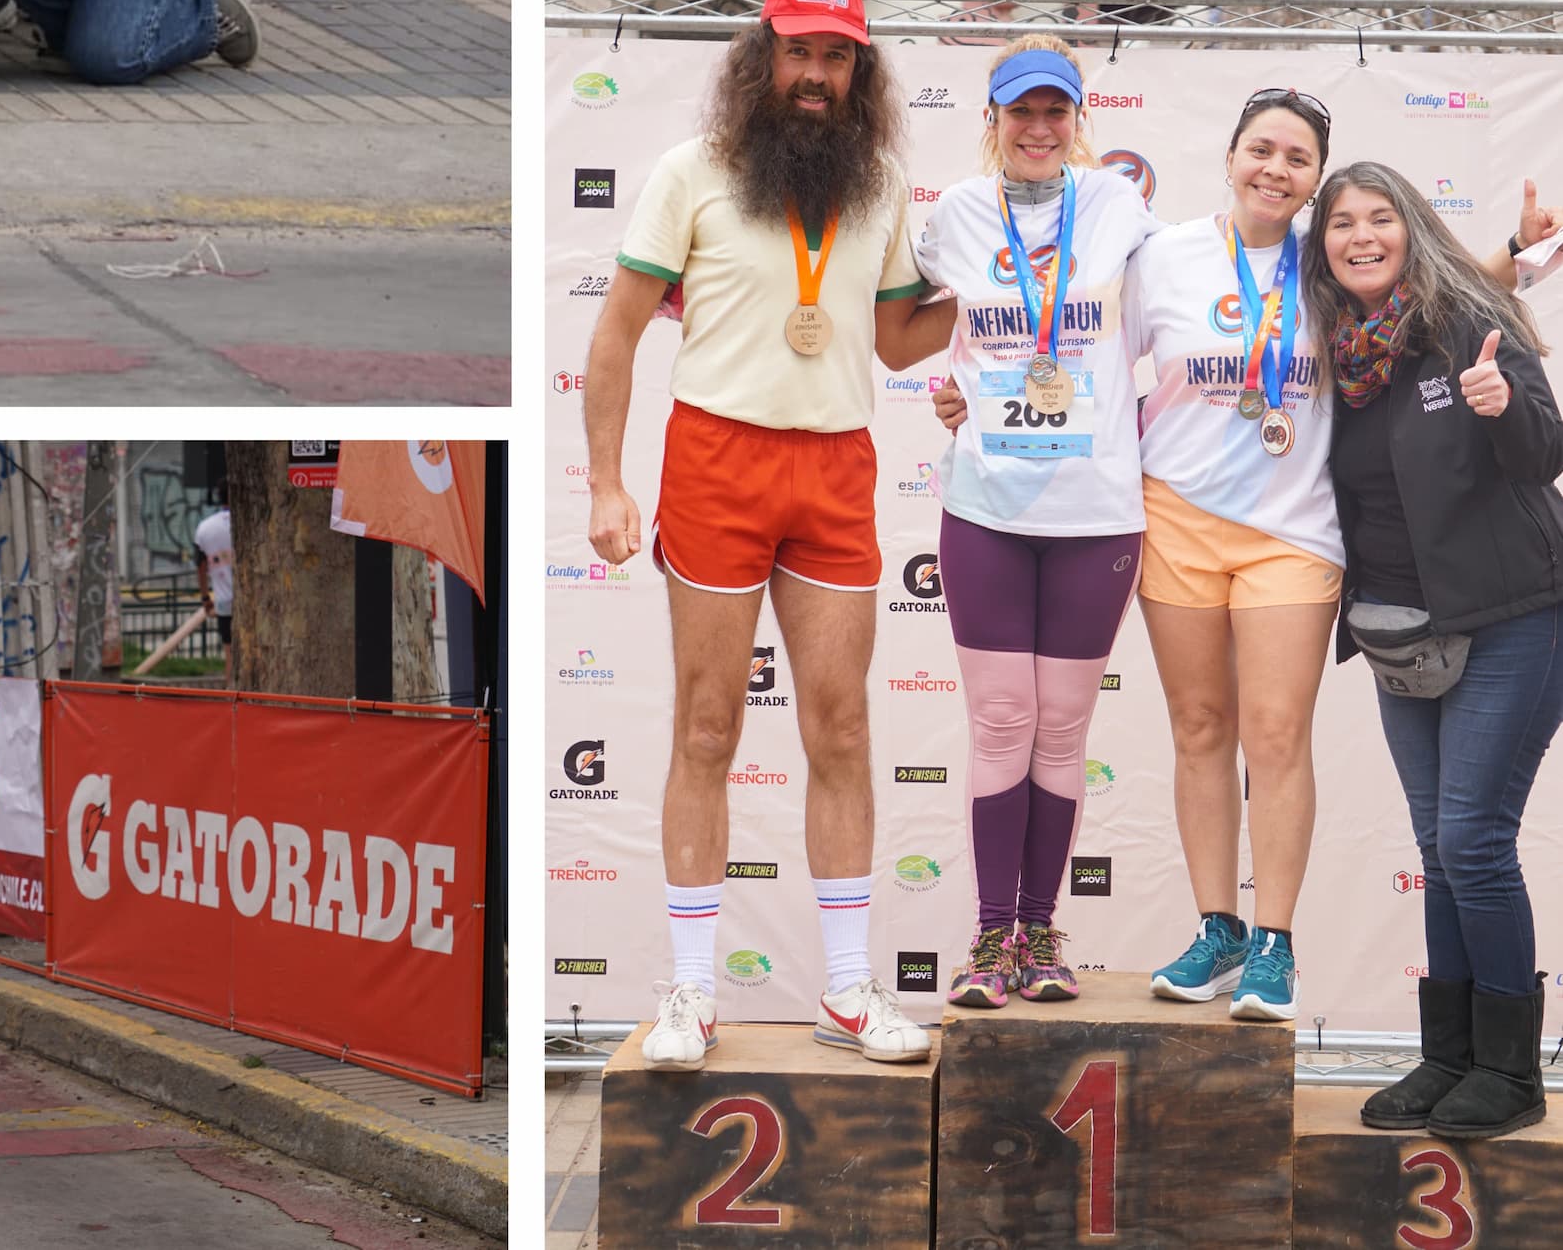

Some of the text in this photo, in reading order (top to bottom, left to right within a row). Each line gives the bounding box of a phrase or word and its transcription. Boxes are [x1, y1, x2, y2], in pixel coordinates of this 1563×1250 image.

[909, 101, 956, 110] RUNNERSZIK
[1088, 92, 1143, 108] Basani
[1405, 92, 1446, 109] Contigo
[578, 180, 610, 188] COLOR
[580, 188, 610, 196] MOVE
[982, 339, 1018, 350] CORRIDA
[886, 376, 927, 394] Contigo
[1200, 388, 1238, 400] CORRIDA
[1423, 397, 1454, 414] Nestlé
[547, 564, 587, 581] Contigo
[558, 667, 615, 680] espress
[888, 679, 957, 692] TRENCITO
[563, 739, 605, 786] G
[907, 769, 946, 782] FINISHER
[549, 789, 619, 800] GATORADE
[67, 773, 456, 955] G GATORADE
[548, 869, 617, 882] TRENCITO
[738, 864, 777, 878] FINISHER
[1075, 868, 1106, 876] COLOR
[1078, 876, 1106, 884] MOVE
[567, 960, 606, 974] FINISHER
[901, 963, 932, 972] COLOR
[904, 971, 932, 980] MOVE
[1050, 1060, 1117, 1236] 1
[689, 1096, 781, 1225] 2
[1397, 1150, 1474, 1250] 3
